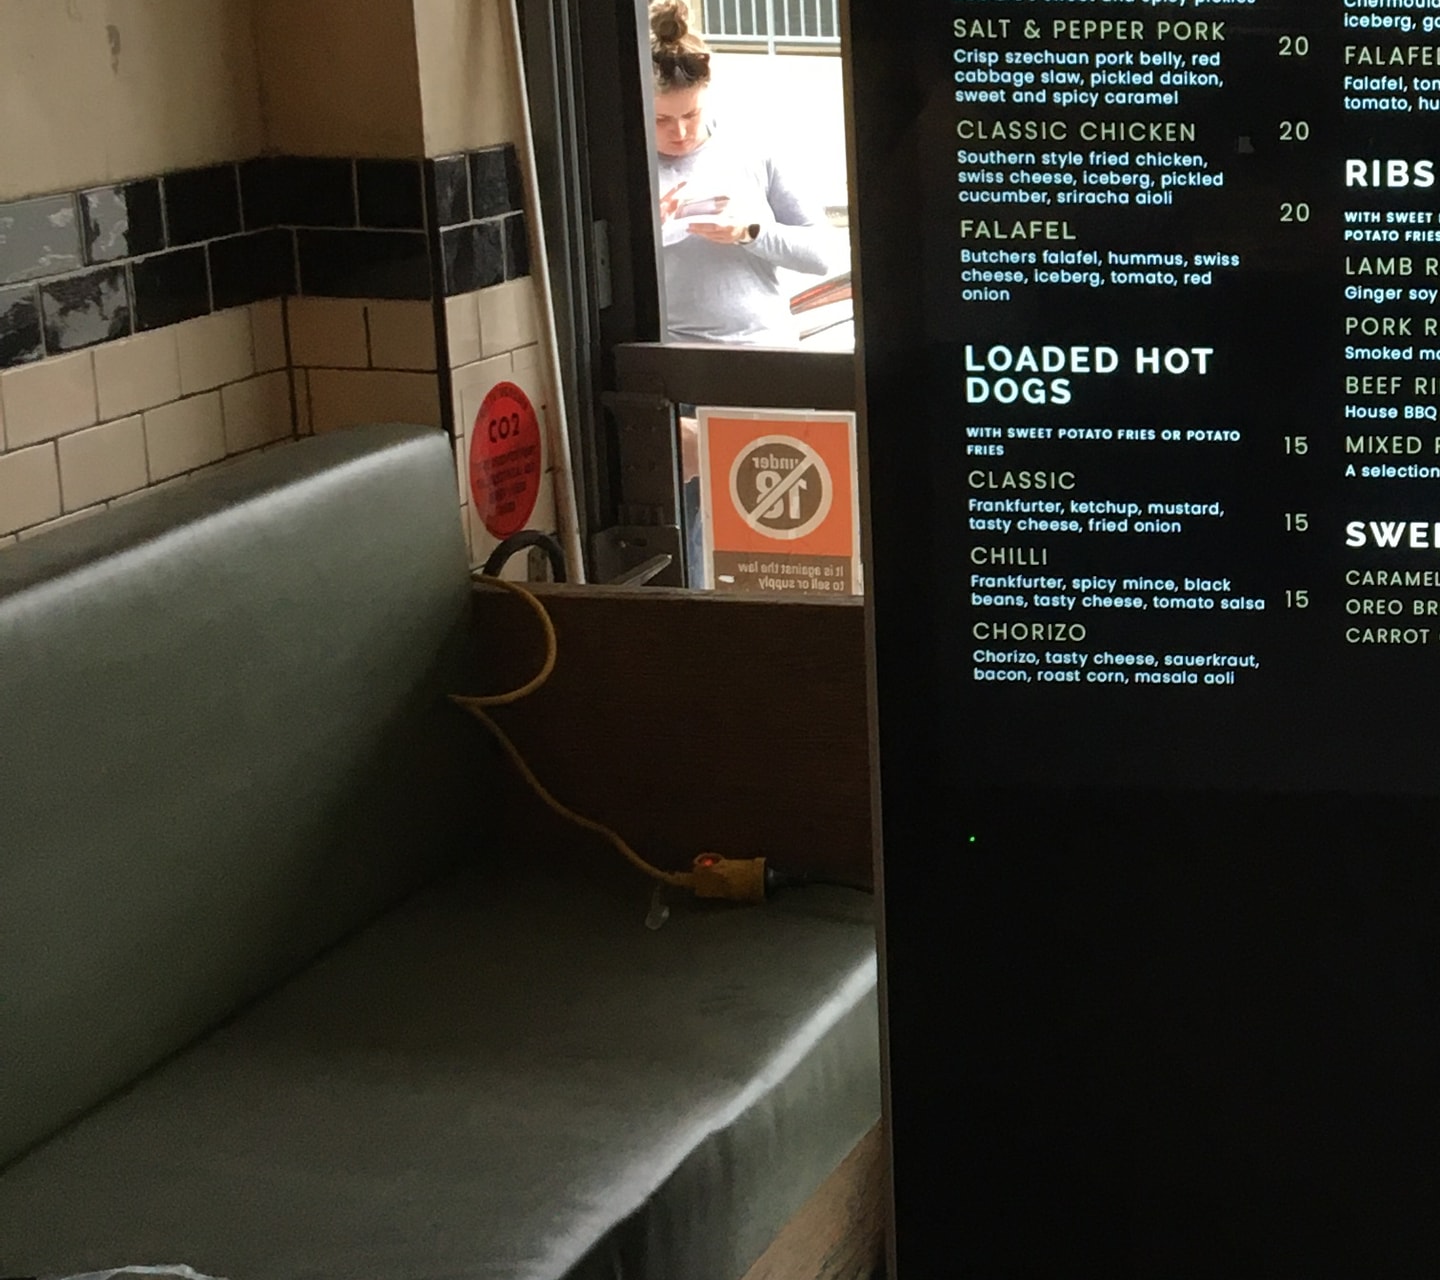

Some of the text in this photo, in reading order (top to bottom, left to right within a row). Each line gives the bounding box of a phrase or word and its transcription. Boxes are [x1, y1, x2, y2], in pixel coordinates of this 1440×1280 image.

[953, 18, 1225, 41] SALT & PEPPER PORK
[1278, 35, 1309, 56] 20
[953, 48, 1221, 70] Crisp szechuan pork belly, red
[956, 119, 1195, 142] CLASSIC CHICKEN
[1279, 120, 1310, 141] 20
[1345, 159, 1435, 188] RIBS
[1280, 202, 1310, 222] 20
[960, 219, 1077, 240] FALAFEL
[1345, 256, 1413, 276] LAMB
[1345, 316, 1412, 336] PORK
[965, 344, 1214, 375] LOADED HOT
[1344, 345, 1413, 361] Smoked
[966, 376, 1072, 405] DOGS
[1345, 375, 1402, 395] BEEF
[1284, 436, 1309, 455] 15
[1346, 435, 1422, 455] MIXED
[968, 470, 1076, 490] CLASSIC
[1344, 463, 1356, 477] A
[1361, 463, 1440, 479] selection
[968, 517, 1182, 534] tasty cheese, fried onion
[1284, 513, 1309, 532] 15
[970, 546, 1047, 566] CHILLI
[1285, 589, 1309, 609] 15
[1345, 598, 1403, 615] OREO
[972, 621, 1087, 642] CHORIZO
[1345, 627, 1430, 644] CARROT
